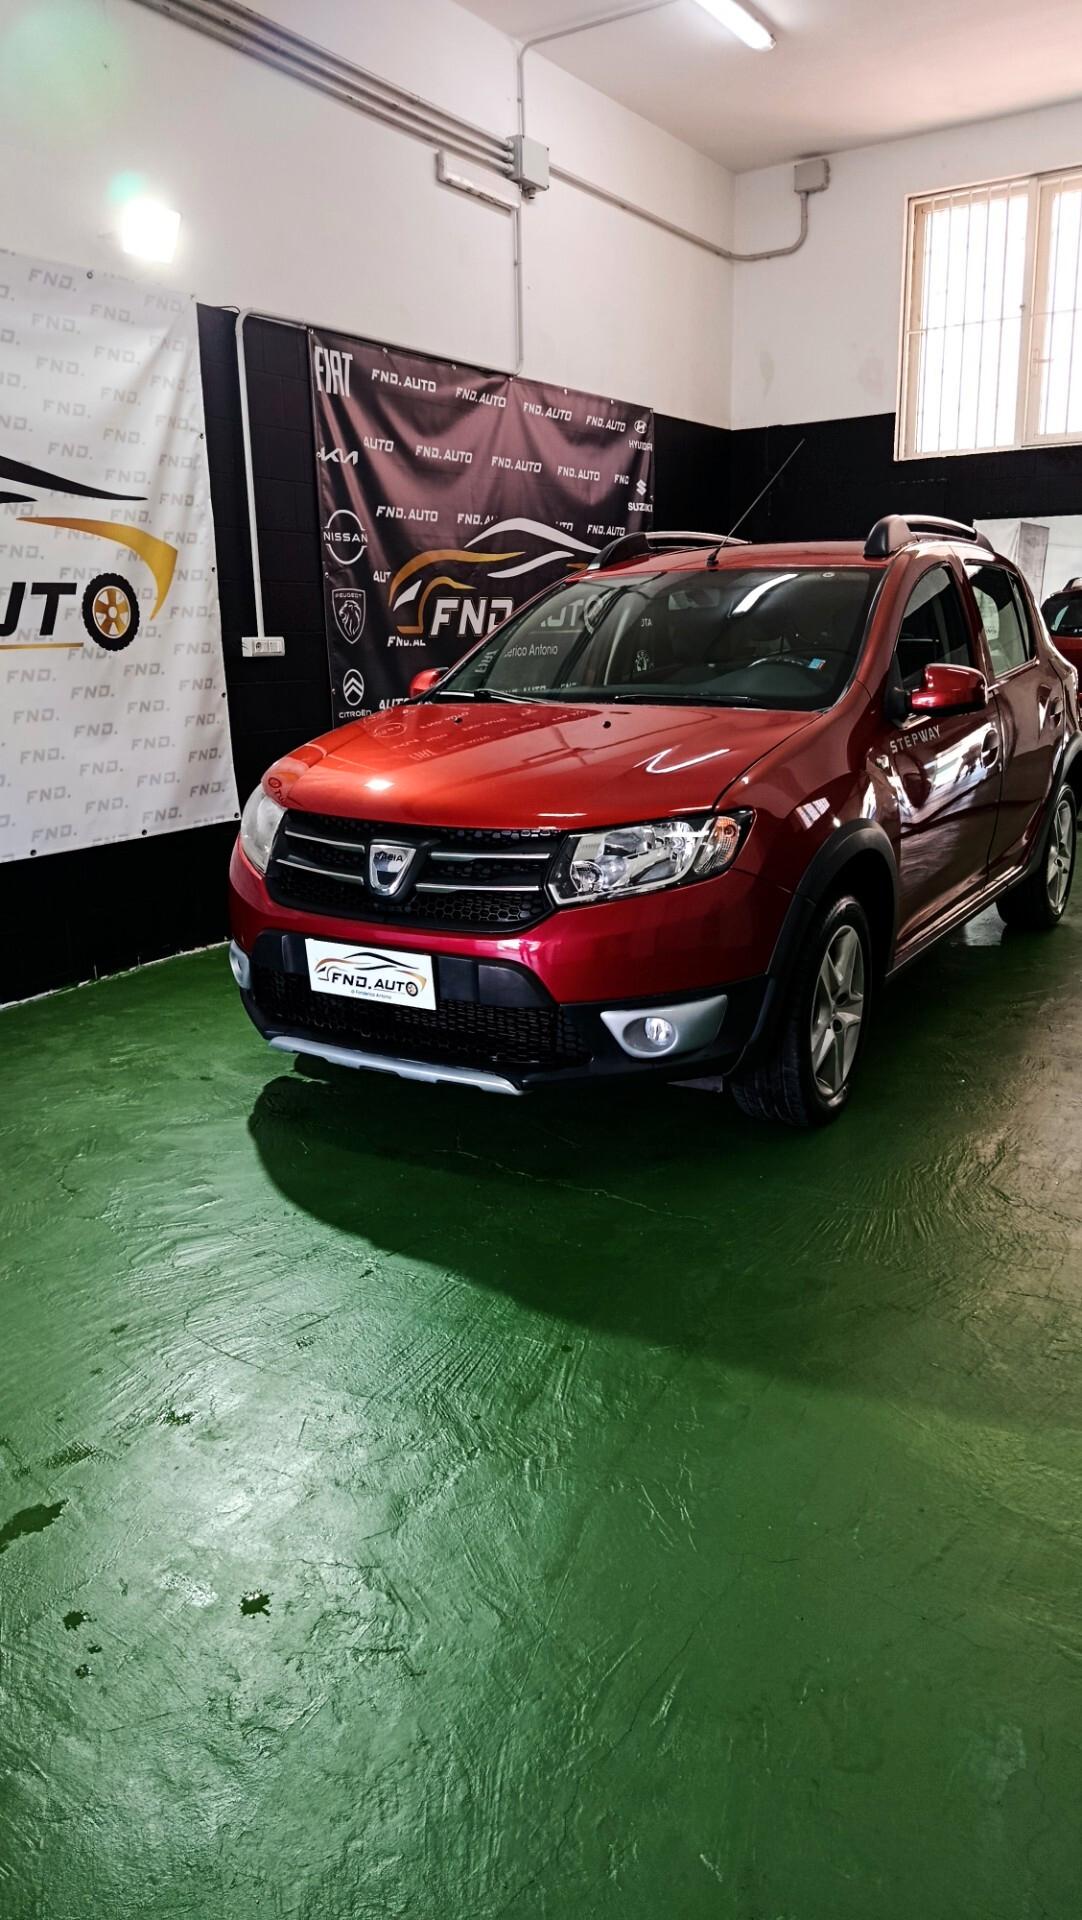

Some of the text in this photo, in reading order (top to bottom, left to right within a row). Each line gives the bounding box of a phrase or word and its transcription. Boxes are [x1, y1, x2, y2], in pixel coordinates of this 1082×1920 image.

[314, 346, 353, 397] FIAT
[0, 413, 33, 432] ND.
[364, 436, 394, 452] AUTO
[415, 445, 473, 464] FND.AUTO
[491, 456, 542, 473] FND.AUTO
[557, 466, 600, 481] FND.AUTO
[3, 502, 39, 517] ND.
[376, 506, 438, 522] FND.AUTO
[323, 531, 368, 543] NISSAN
[586, 524, 626, 536] FND.AUTO
[176, 568, 208, 582] ND.
[528, 643, 558, 656] Antonio
[890, 725, 940, 753] STEPWAY
